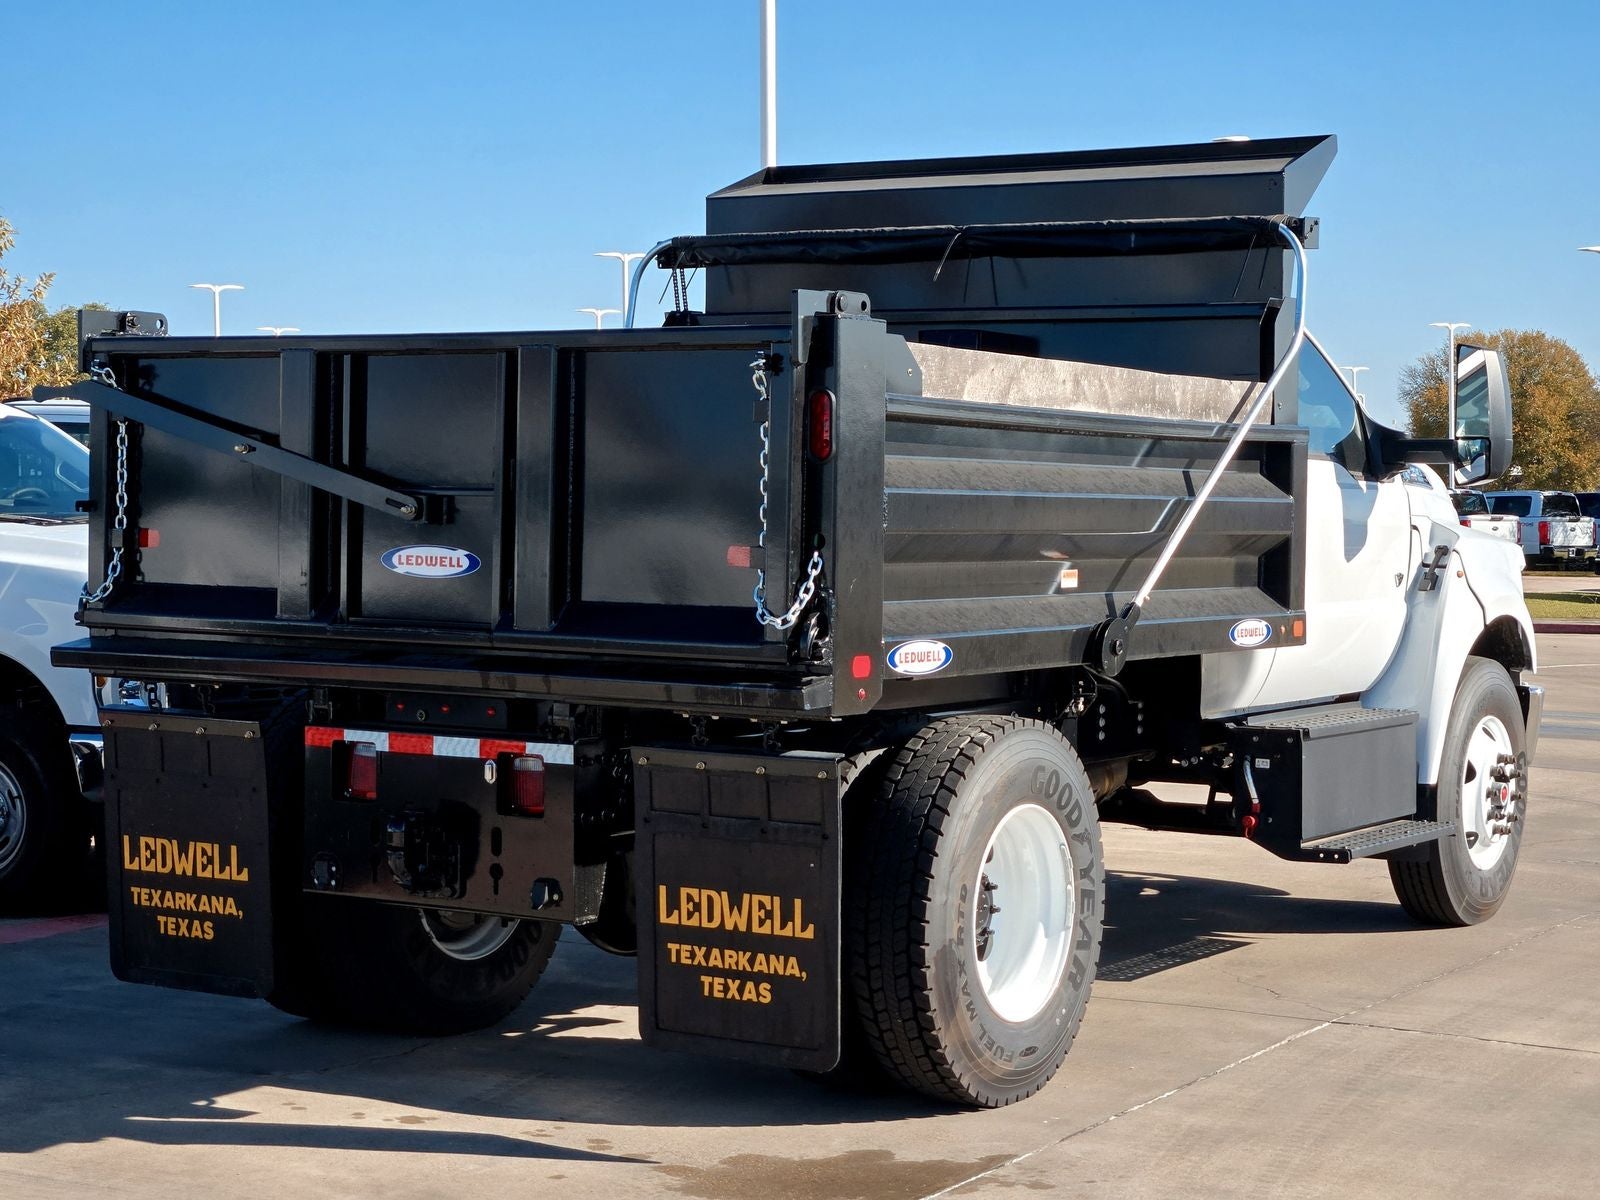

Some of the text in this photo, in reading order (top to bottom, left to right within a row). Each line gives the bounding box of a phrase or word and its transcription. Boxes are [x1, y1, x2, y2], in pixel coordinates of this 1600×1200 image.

[397, 554, 464, 568] LEDWELL
[1236, 627, 1265, 638] LEDWELL
[899, 650, 942, 664] LEDWELL
[123, 834, 249, 882] LEDWELL
[1030, 765, 1096, 992] GOODYEAR
[130, 886, 244, 920] TEXARKANA,
[658, 884, 815, 940] LEDWELL
[156, 915, 215, 940] TEXAS
[667, 942, 808, 982] TEXARKANA,
[956, 883, 1016, 1063] FUEL MAX RTD
[700, 975, 772, 1004] TEXAS
